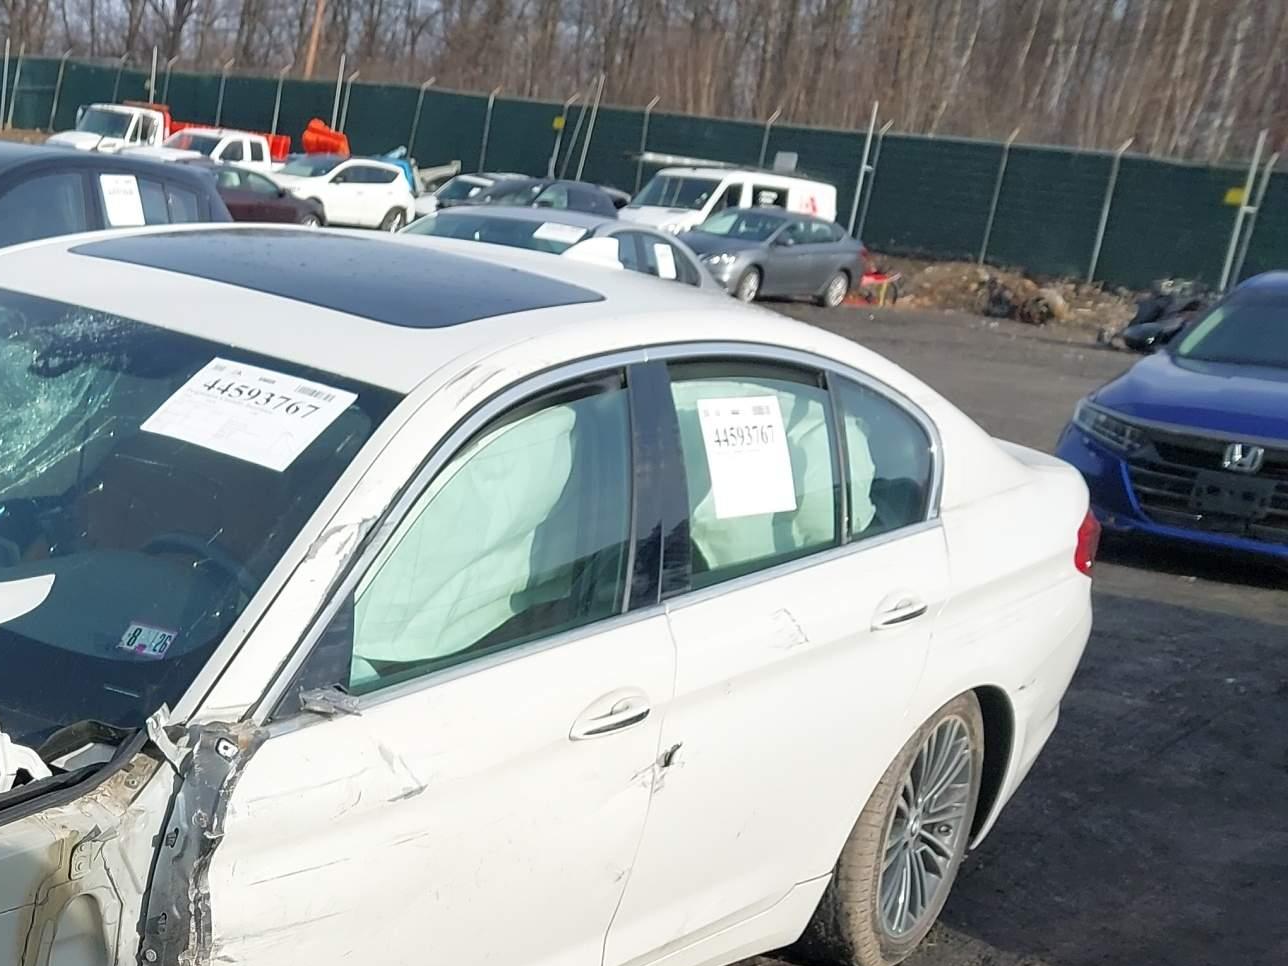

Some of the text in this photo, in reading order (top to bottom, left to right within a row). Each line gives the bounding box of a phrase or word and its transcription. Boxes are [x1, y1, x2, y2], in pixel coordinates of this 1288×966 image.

[203, 379, 320, 418] 44593767
[714, 425, 775, 447] 44593767
[126, 627, 172, 653] 8 26
